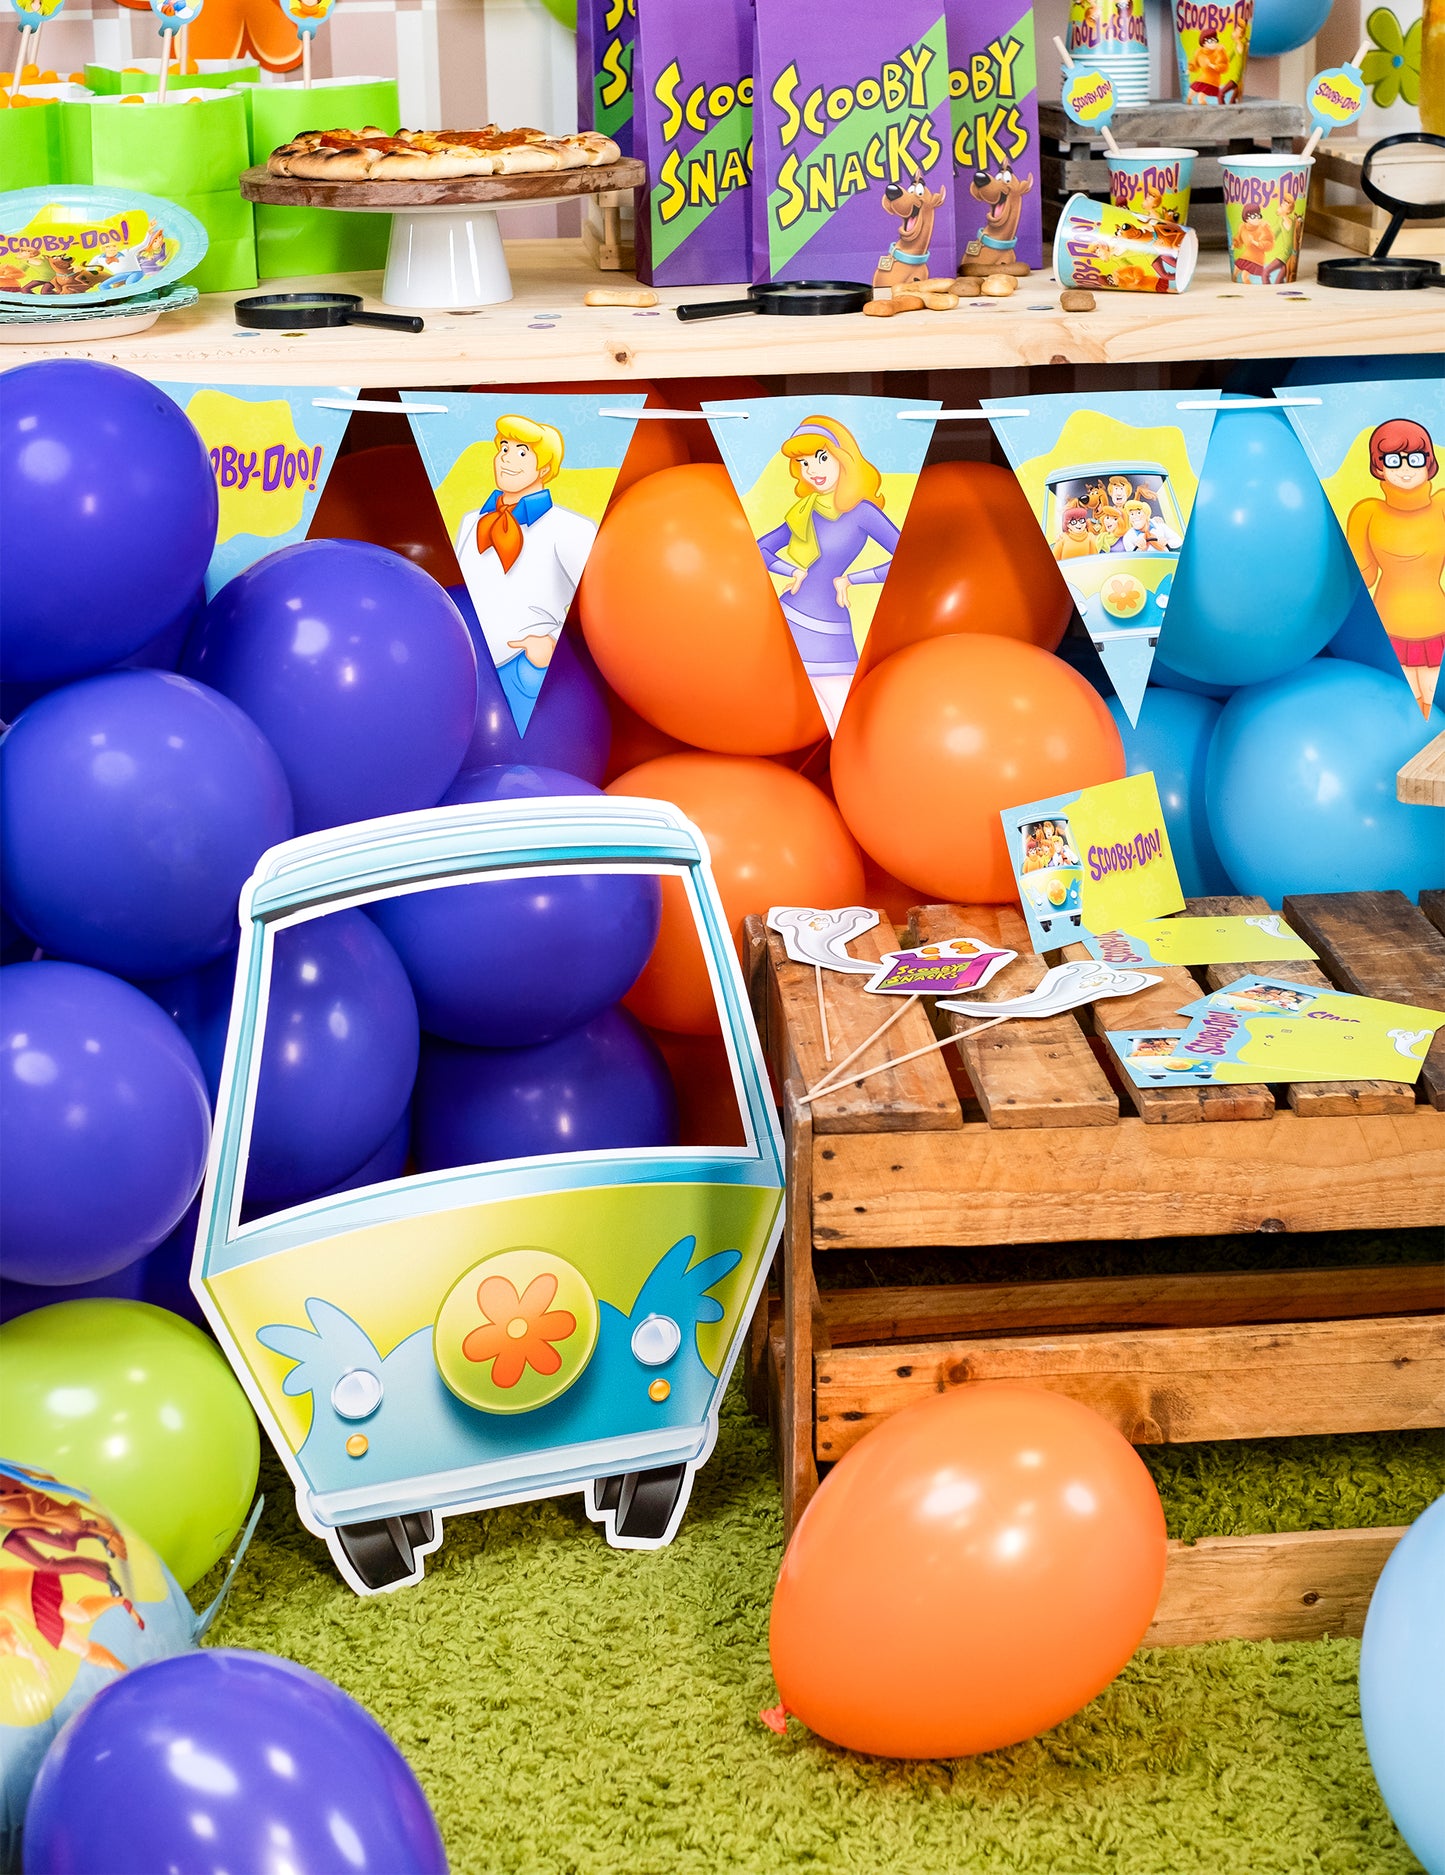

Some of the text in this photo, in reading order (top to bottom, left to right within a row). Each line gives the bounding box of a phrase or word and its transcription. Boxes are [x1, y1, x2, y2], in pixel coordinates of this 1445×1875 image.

[770, 43, 937, 151] SCOOBY
[952, 103, 1030, 176] CKS
[657, 143, 754, 226] SNA
[775, 113, 943, 232] SNACKS
[1222, 166, 1309, 209] SCOOBY-DOO!
[1087, 827, 1163, 881] SCOOBY-DOO!
[885, 972, 958, 985] SNACKS
[896, 964, 965, 975] SCOOBY
[1184, 1010, 1243, 1056] SCOOBY-DOO!
